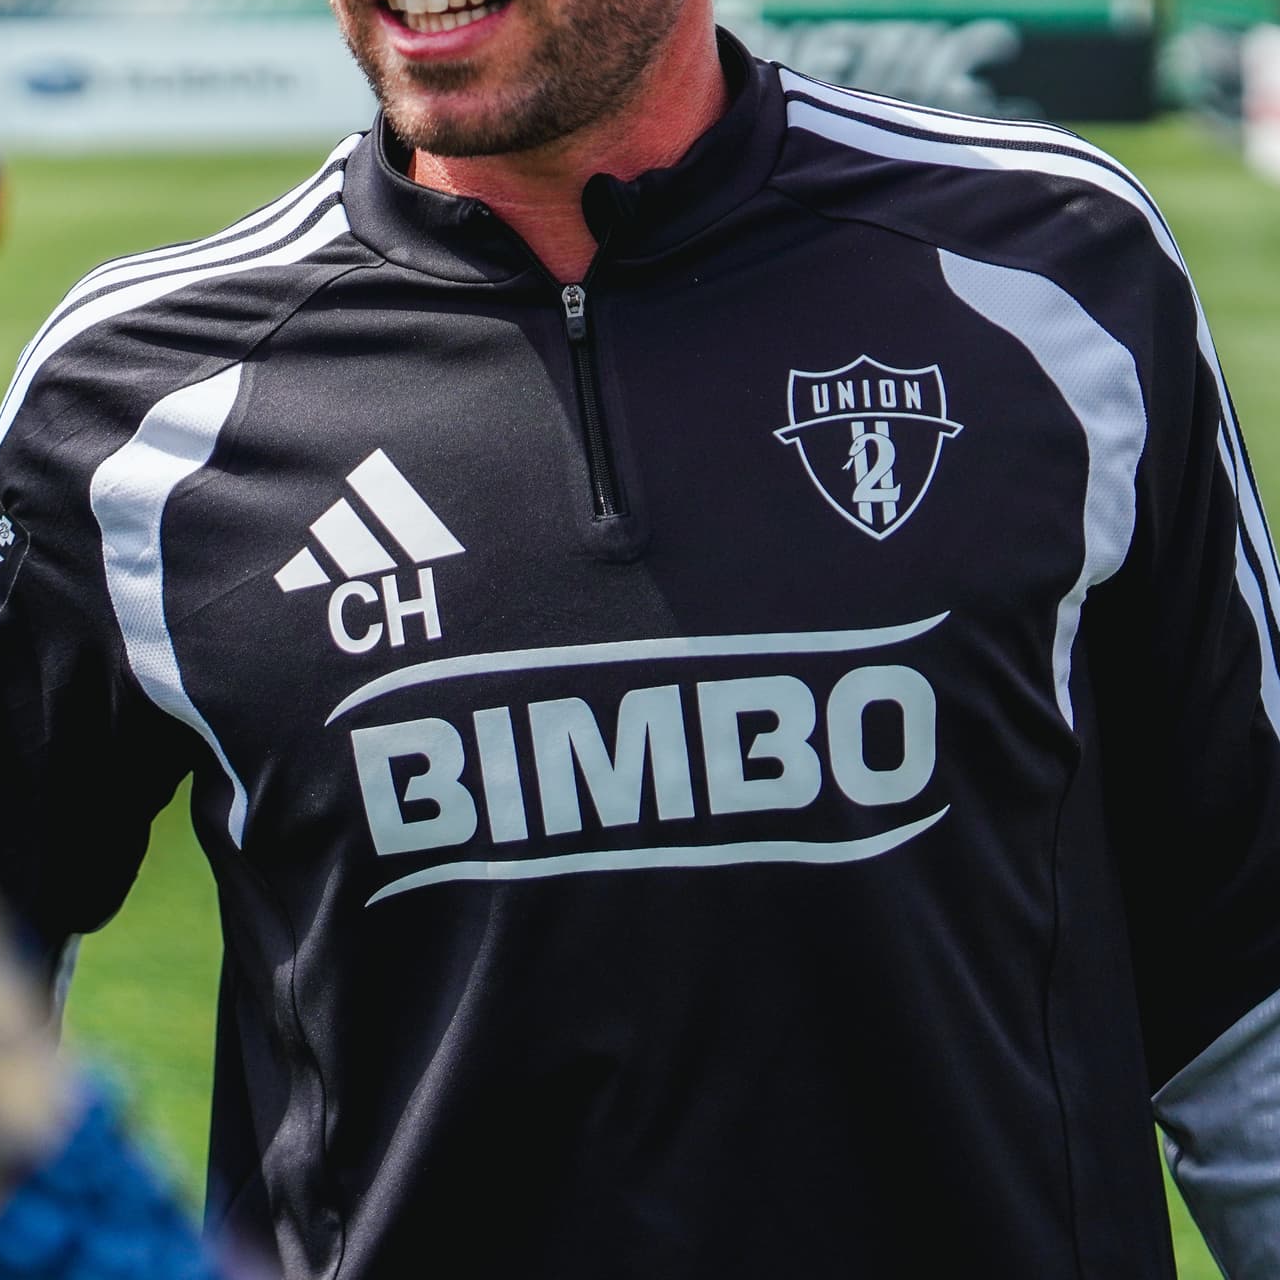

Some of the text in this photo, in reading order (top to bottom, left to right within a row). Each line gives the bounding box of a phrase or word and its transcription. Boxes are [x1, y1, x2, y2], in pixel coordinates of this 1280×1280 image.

[811, 379, 922, 414] UNION
[327, 567, 443, 655] CH
[350, 664, 937, 857] BIMBO
